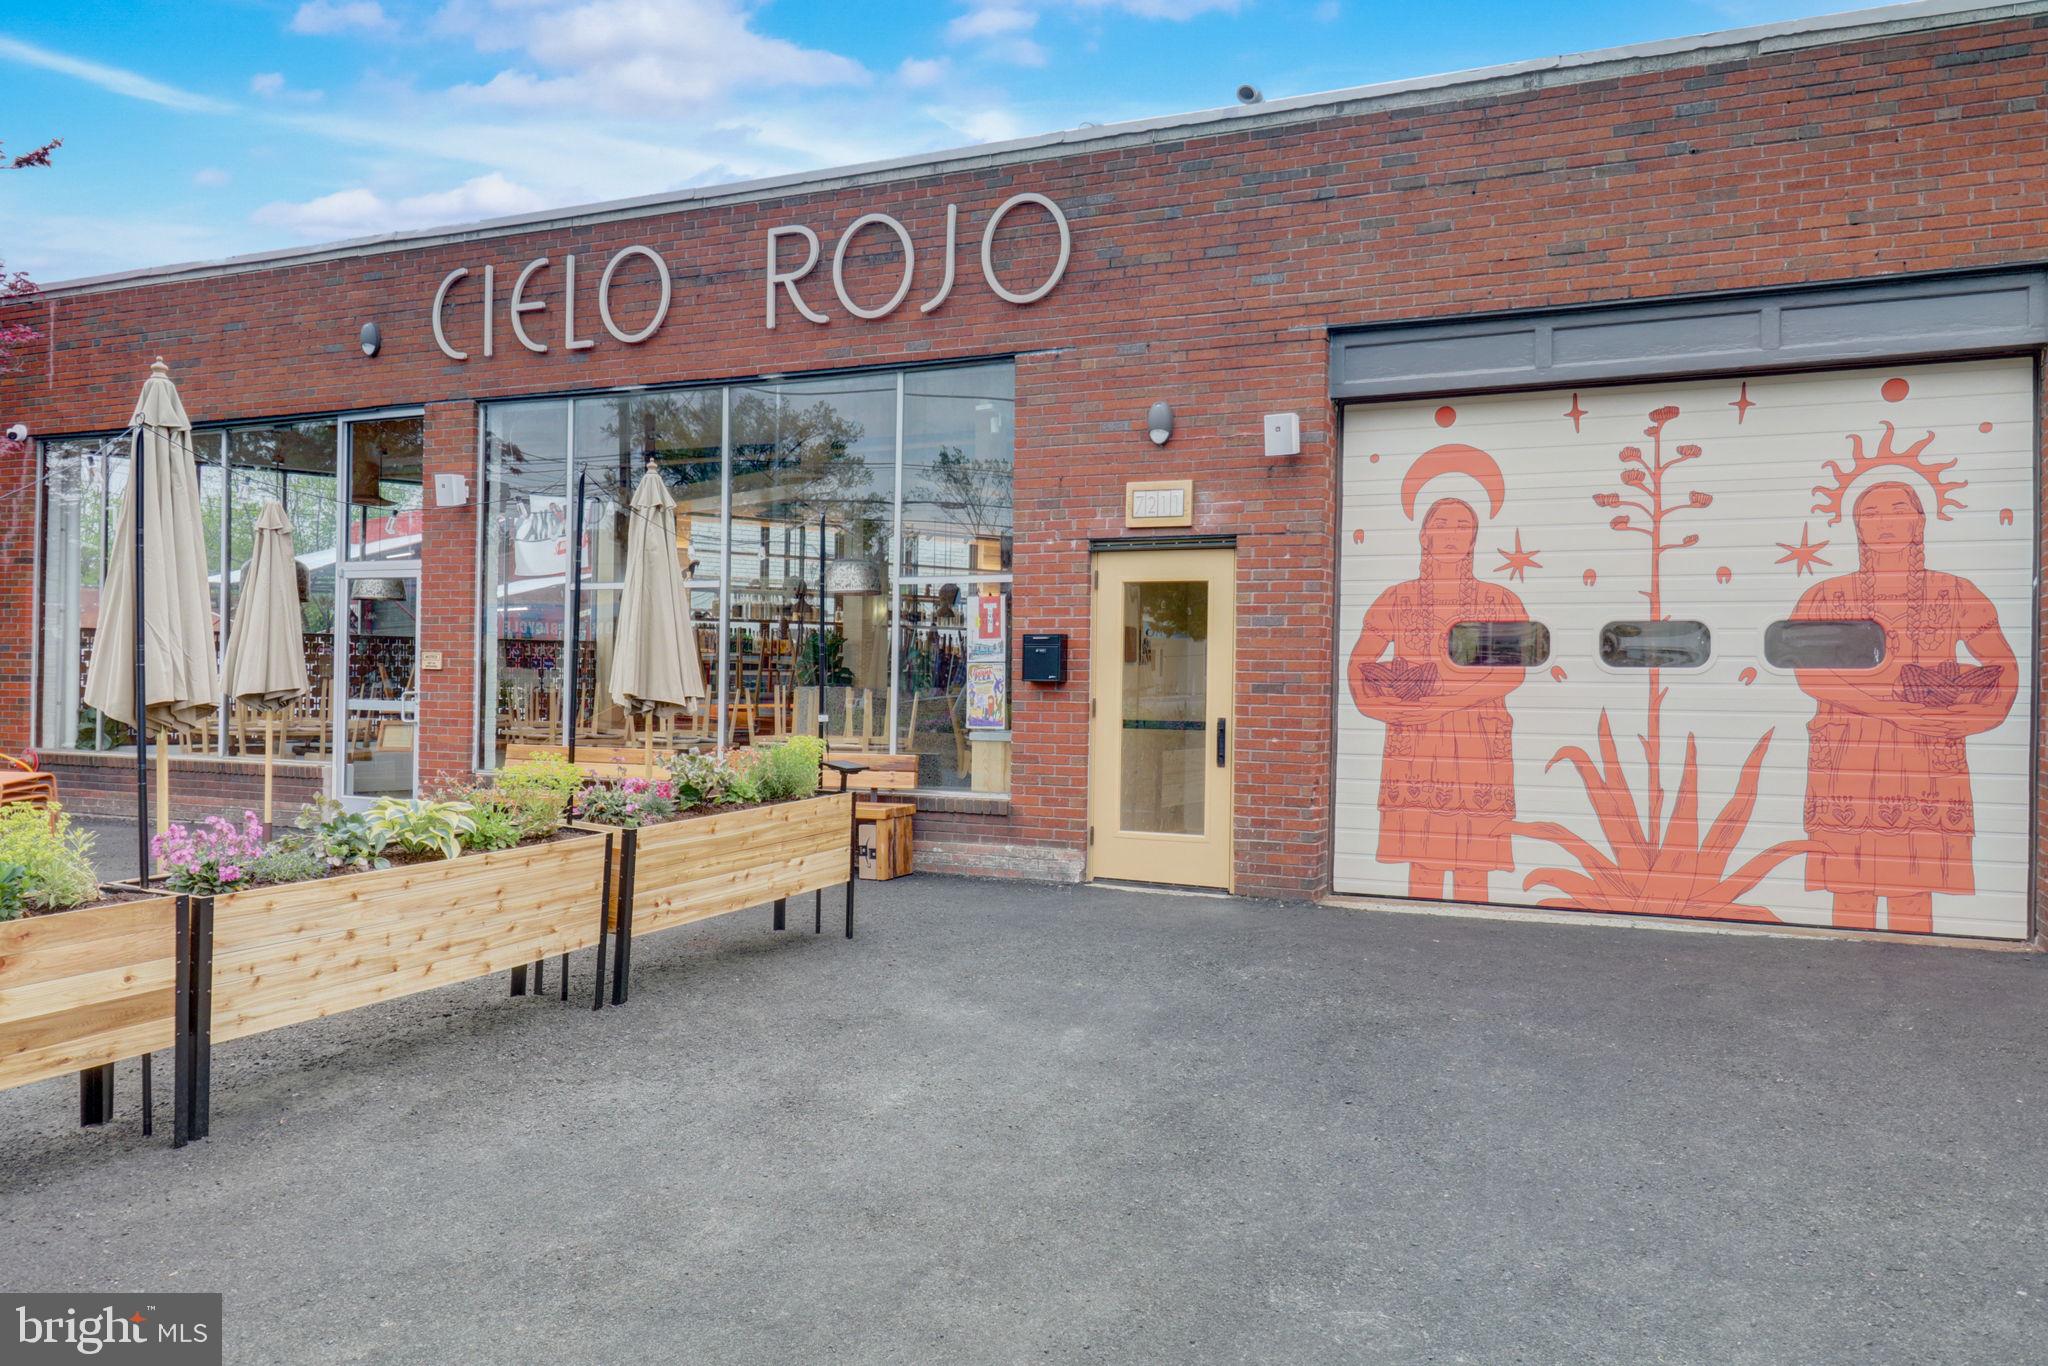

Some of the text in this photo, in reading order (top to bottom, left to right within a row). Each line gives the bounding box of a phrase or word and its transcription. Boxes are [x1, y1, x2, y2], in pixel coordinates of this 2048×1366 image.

[432, 193, 1072, 360] CIELO ROJO
[1135, 493, 1182, 516] 7211
